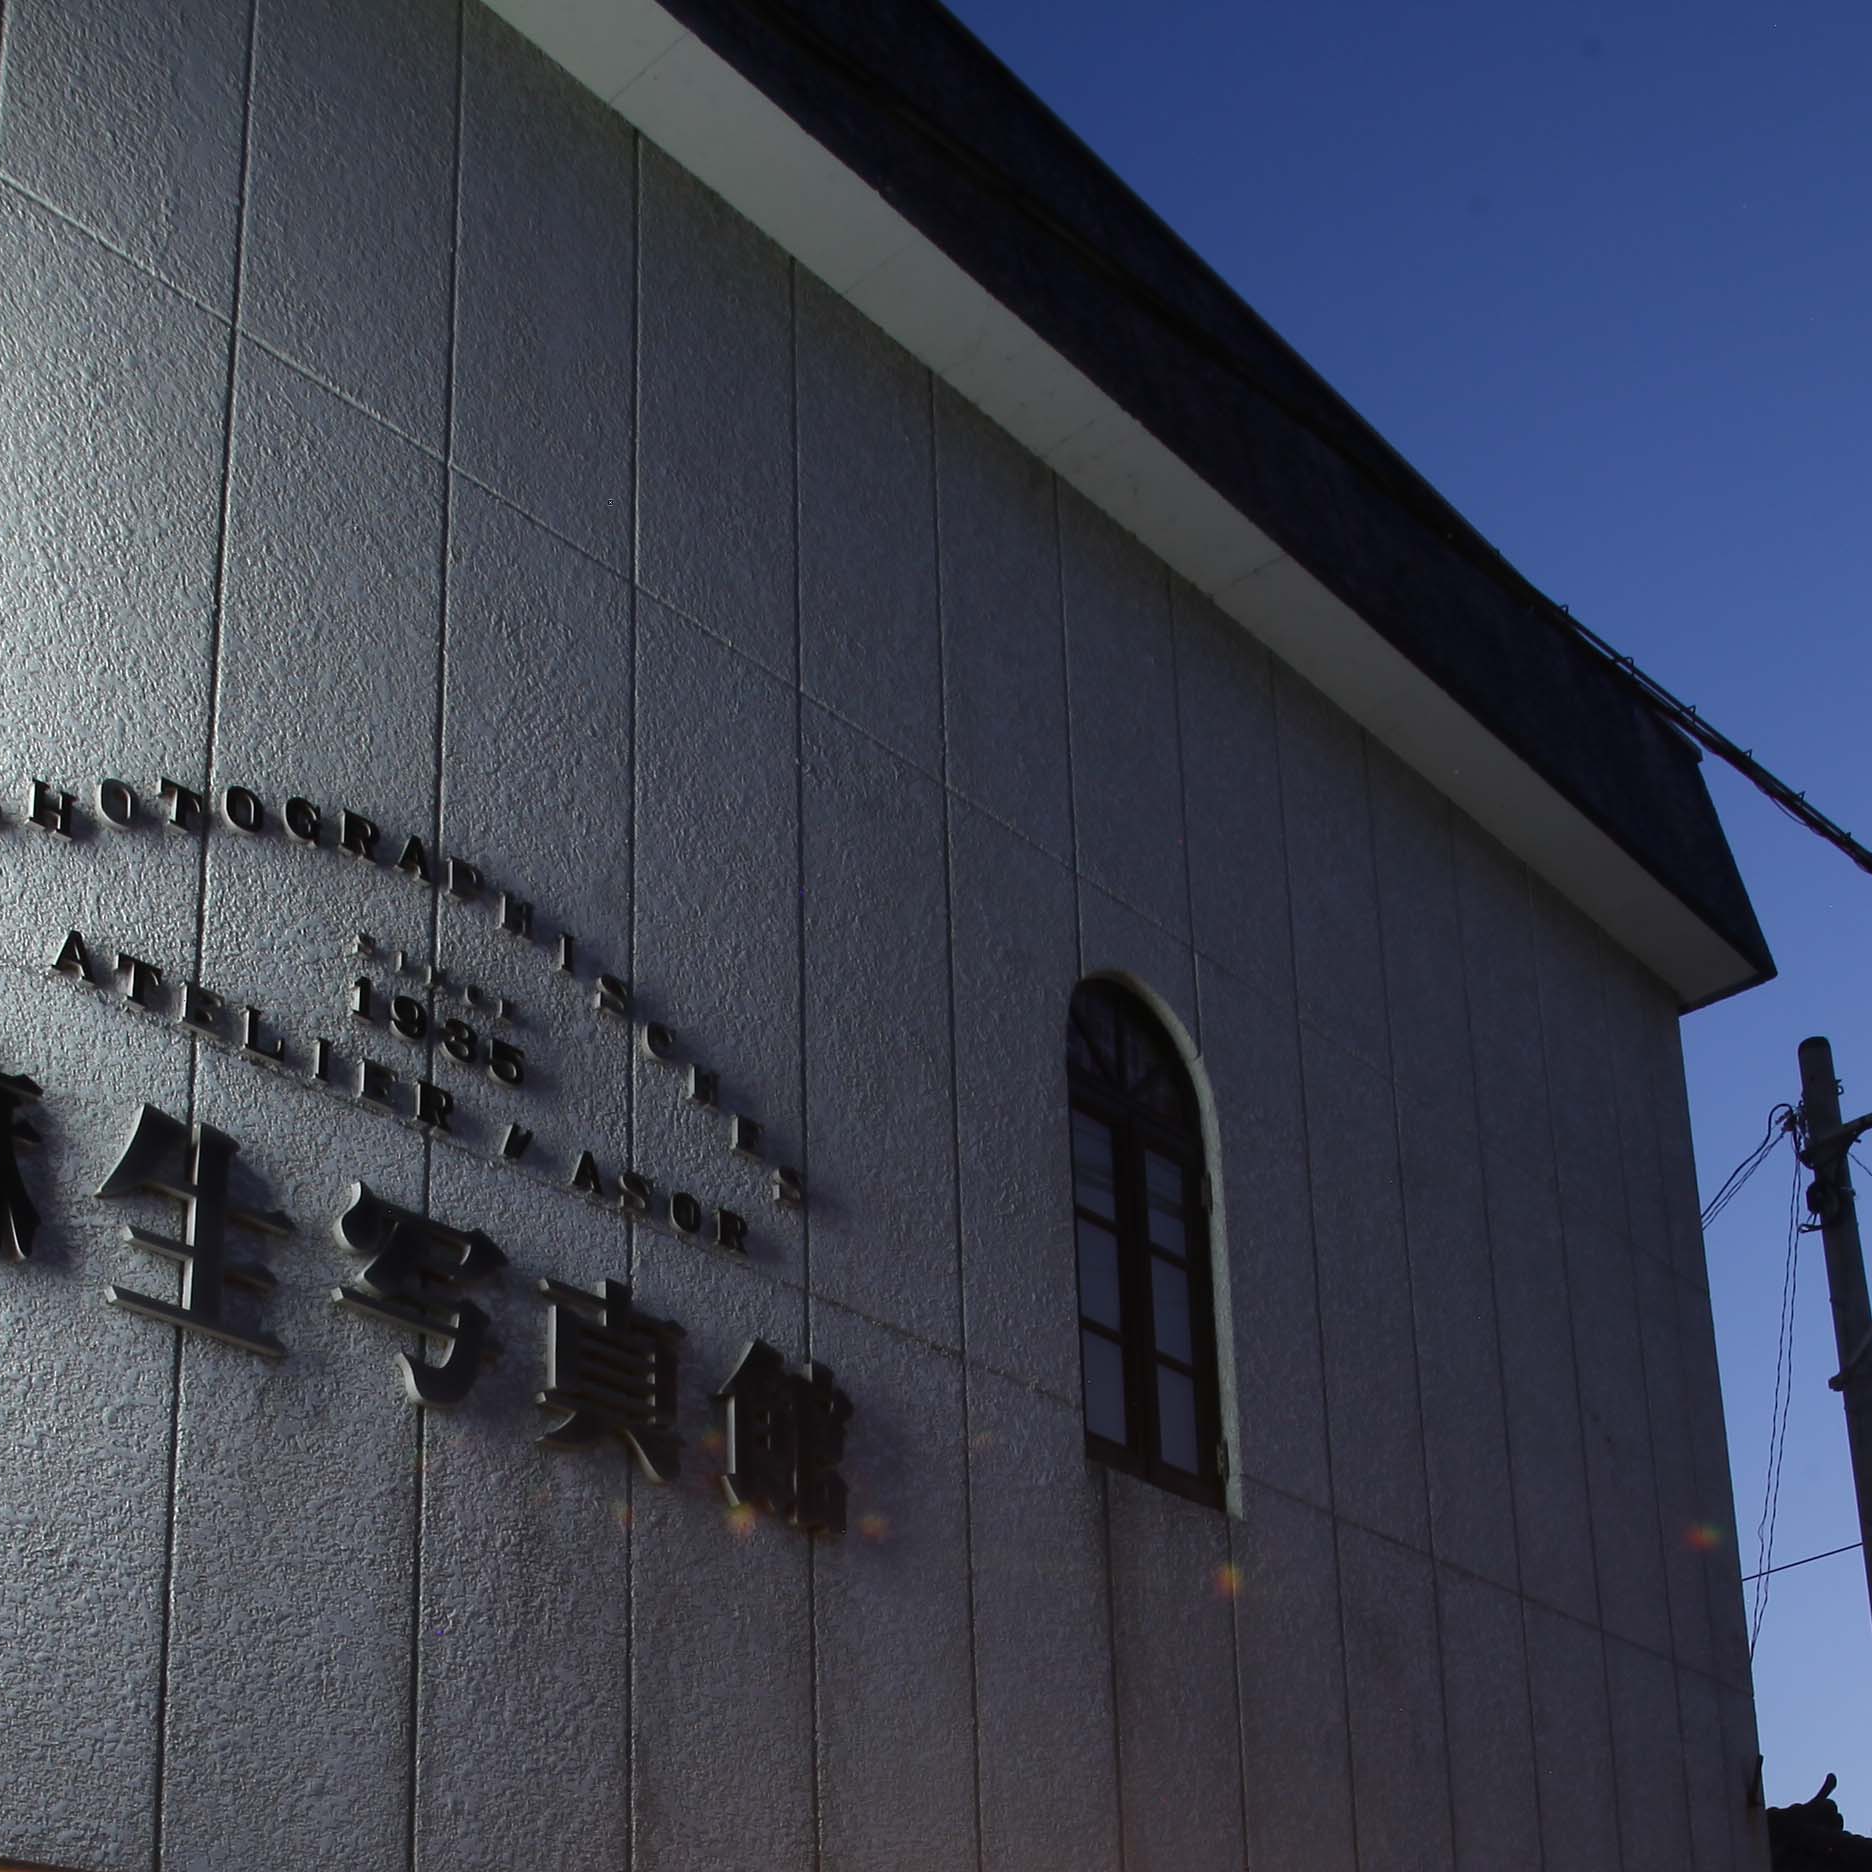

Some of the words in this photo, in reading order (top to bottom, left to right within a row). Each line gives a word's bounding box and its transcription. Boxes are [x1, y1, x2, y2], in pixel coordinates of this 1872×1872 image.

[50, 930, 453, 1136] ATELIER
[569, 1151, 749, 1256] ASOR
[350, 976, 524, 1088] 1935
